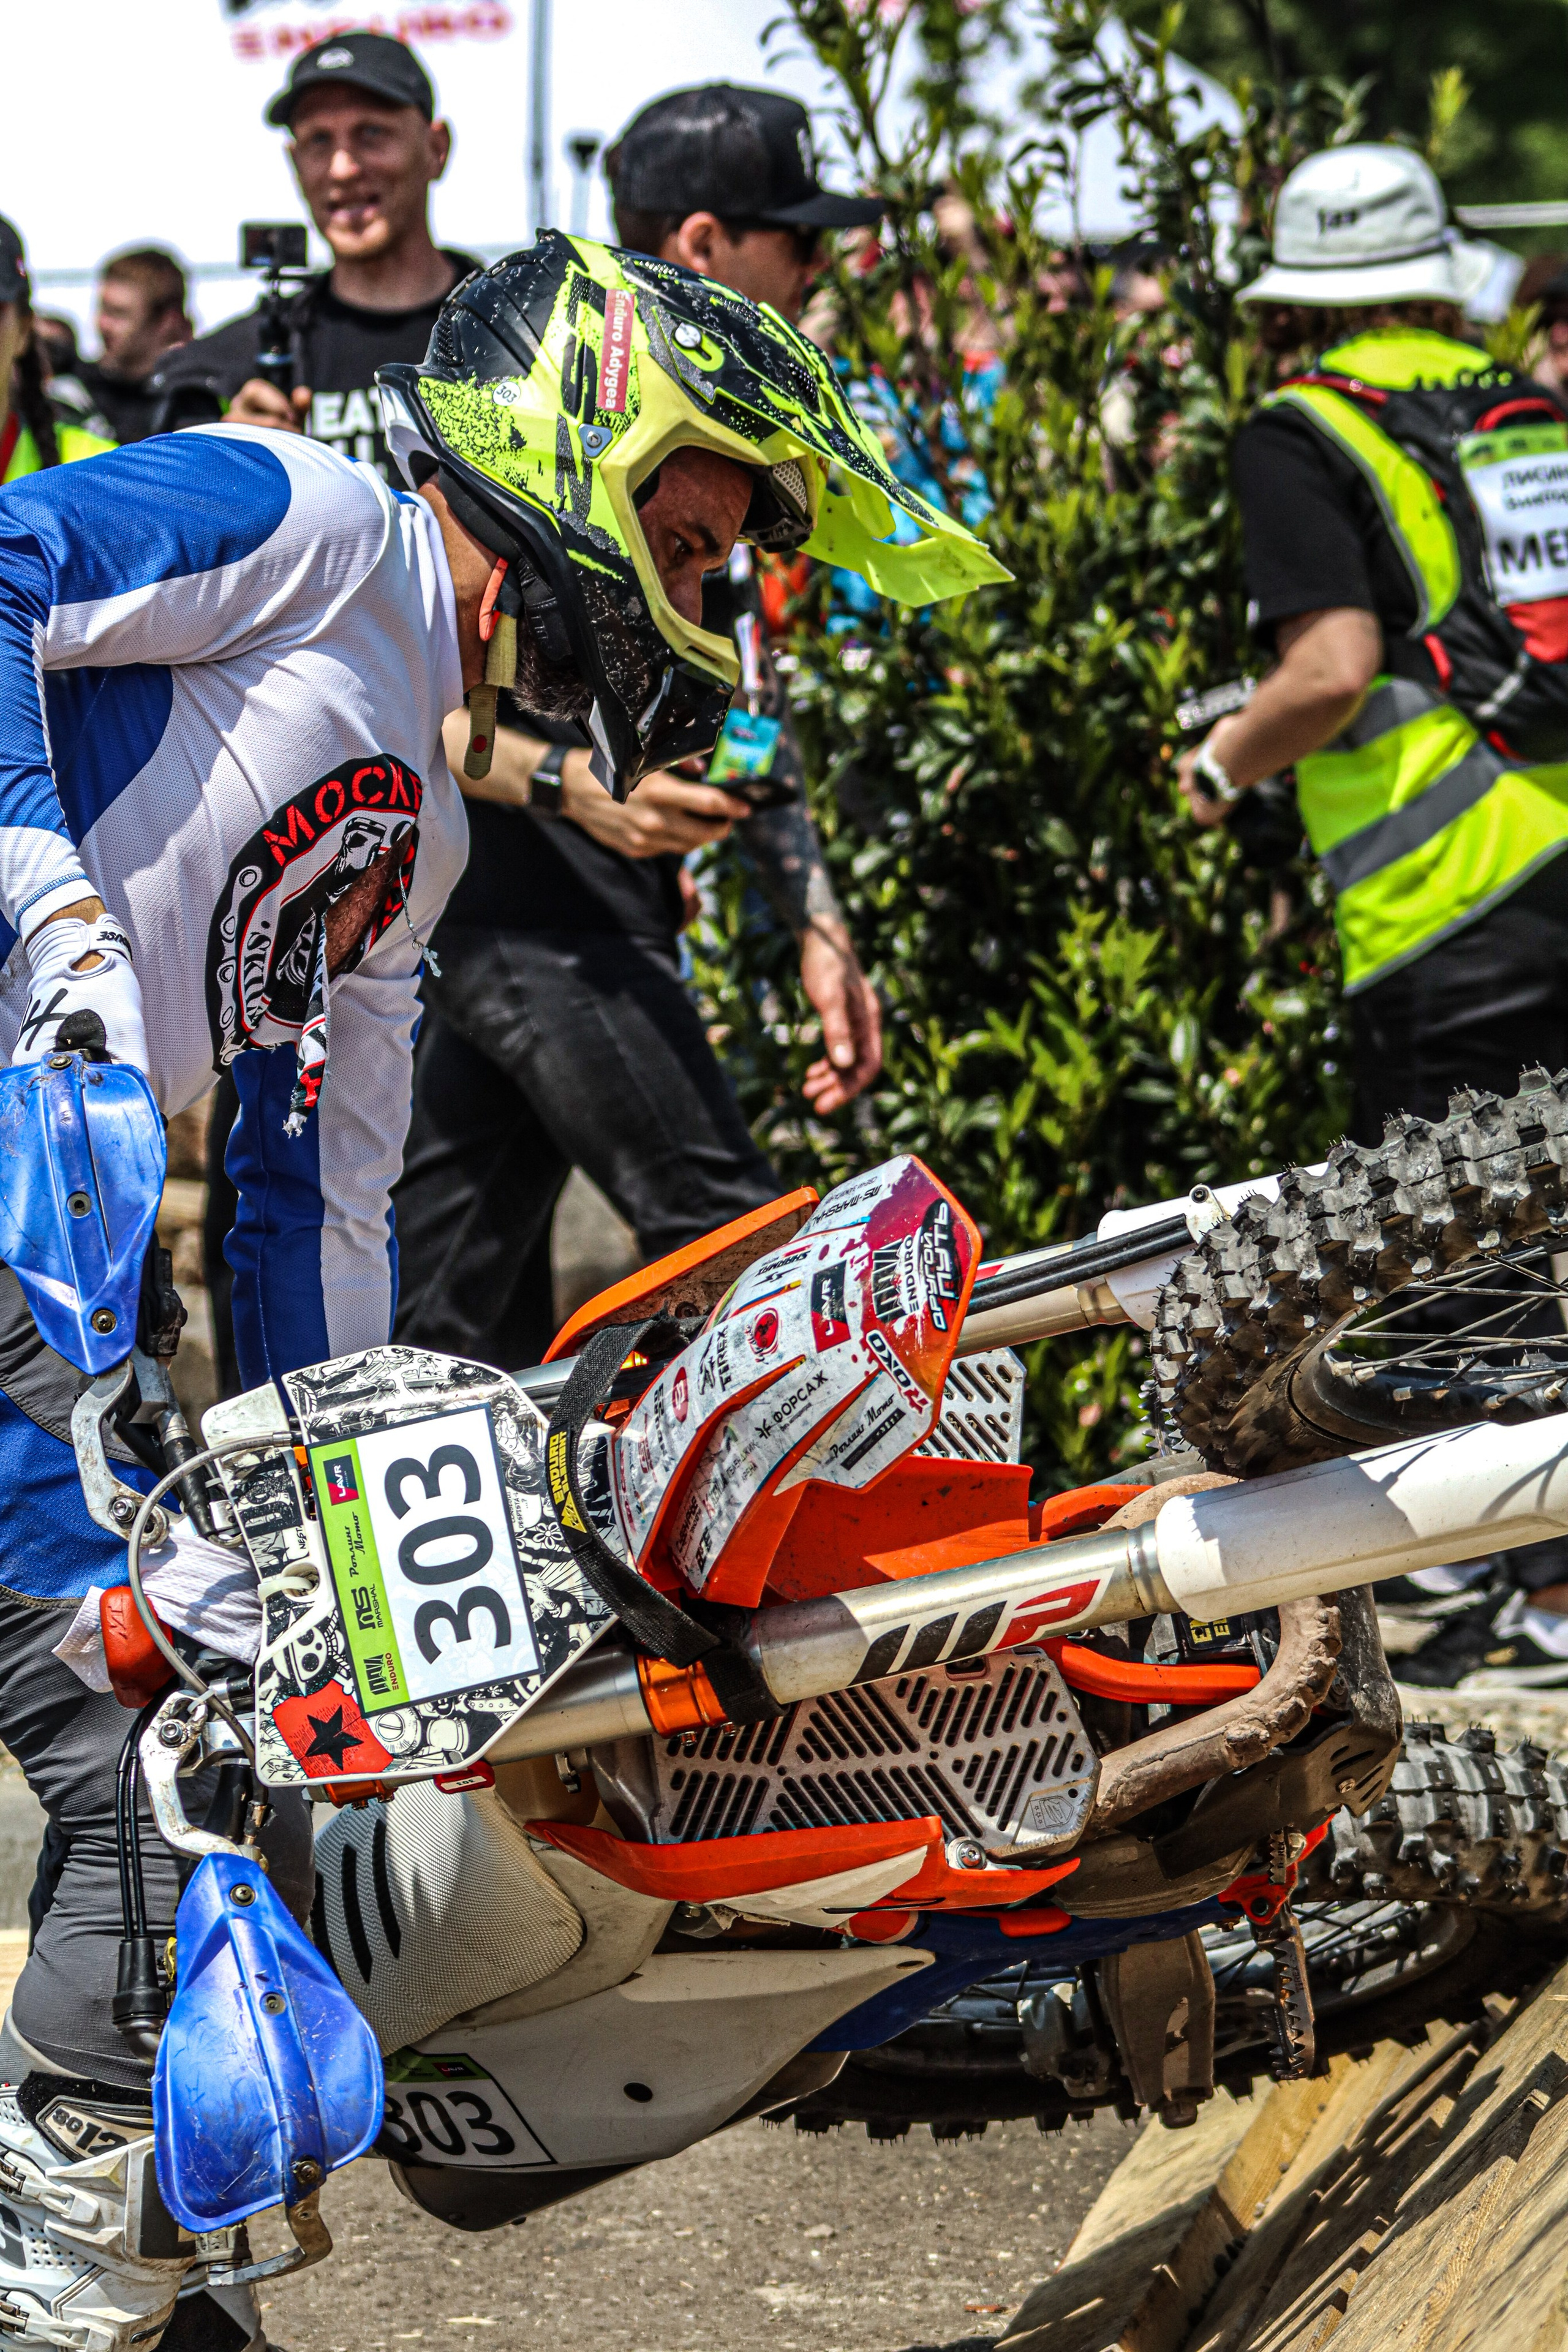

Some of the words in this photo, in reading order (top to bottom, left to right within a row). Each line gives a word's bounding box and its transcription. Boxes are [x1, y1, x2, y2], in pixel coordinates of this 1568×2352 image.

[610, 290, 627, 342] Enduro
[496, 383, 518, 404] 303
[605, 346, 620, 409] Adygea
[307, 387, 386, 437] EAT
[904, 1234, 919, 1313] ENDURO
[933, 1201, 955, 1299] ПУТЬ
[821, 1278, 834, 1336] LAVR
[772, 1370, 828, 1423] ФОРСАЖ
[829, 1424, 865, 1459] Роллинг
[867, 1393, 895, 1426] Мото
[333, 1464, 347, 1498] LAVR
[549, 1433, 565, 1505] ENDURO
[559, 1431, 570, 1495] ELEMENT
[353, 1511, 365, 1555] Мото
[385, 1443, 511, 1665] 303
[370, 1583, 383, 1628] MARSHAL
[386, 1652, 399, 1691] ENDURO
